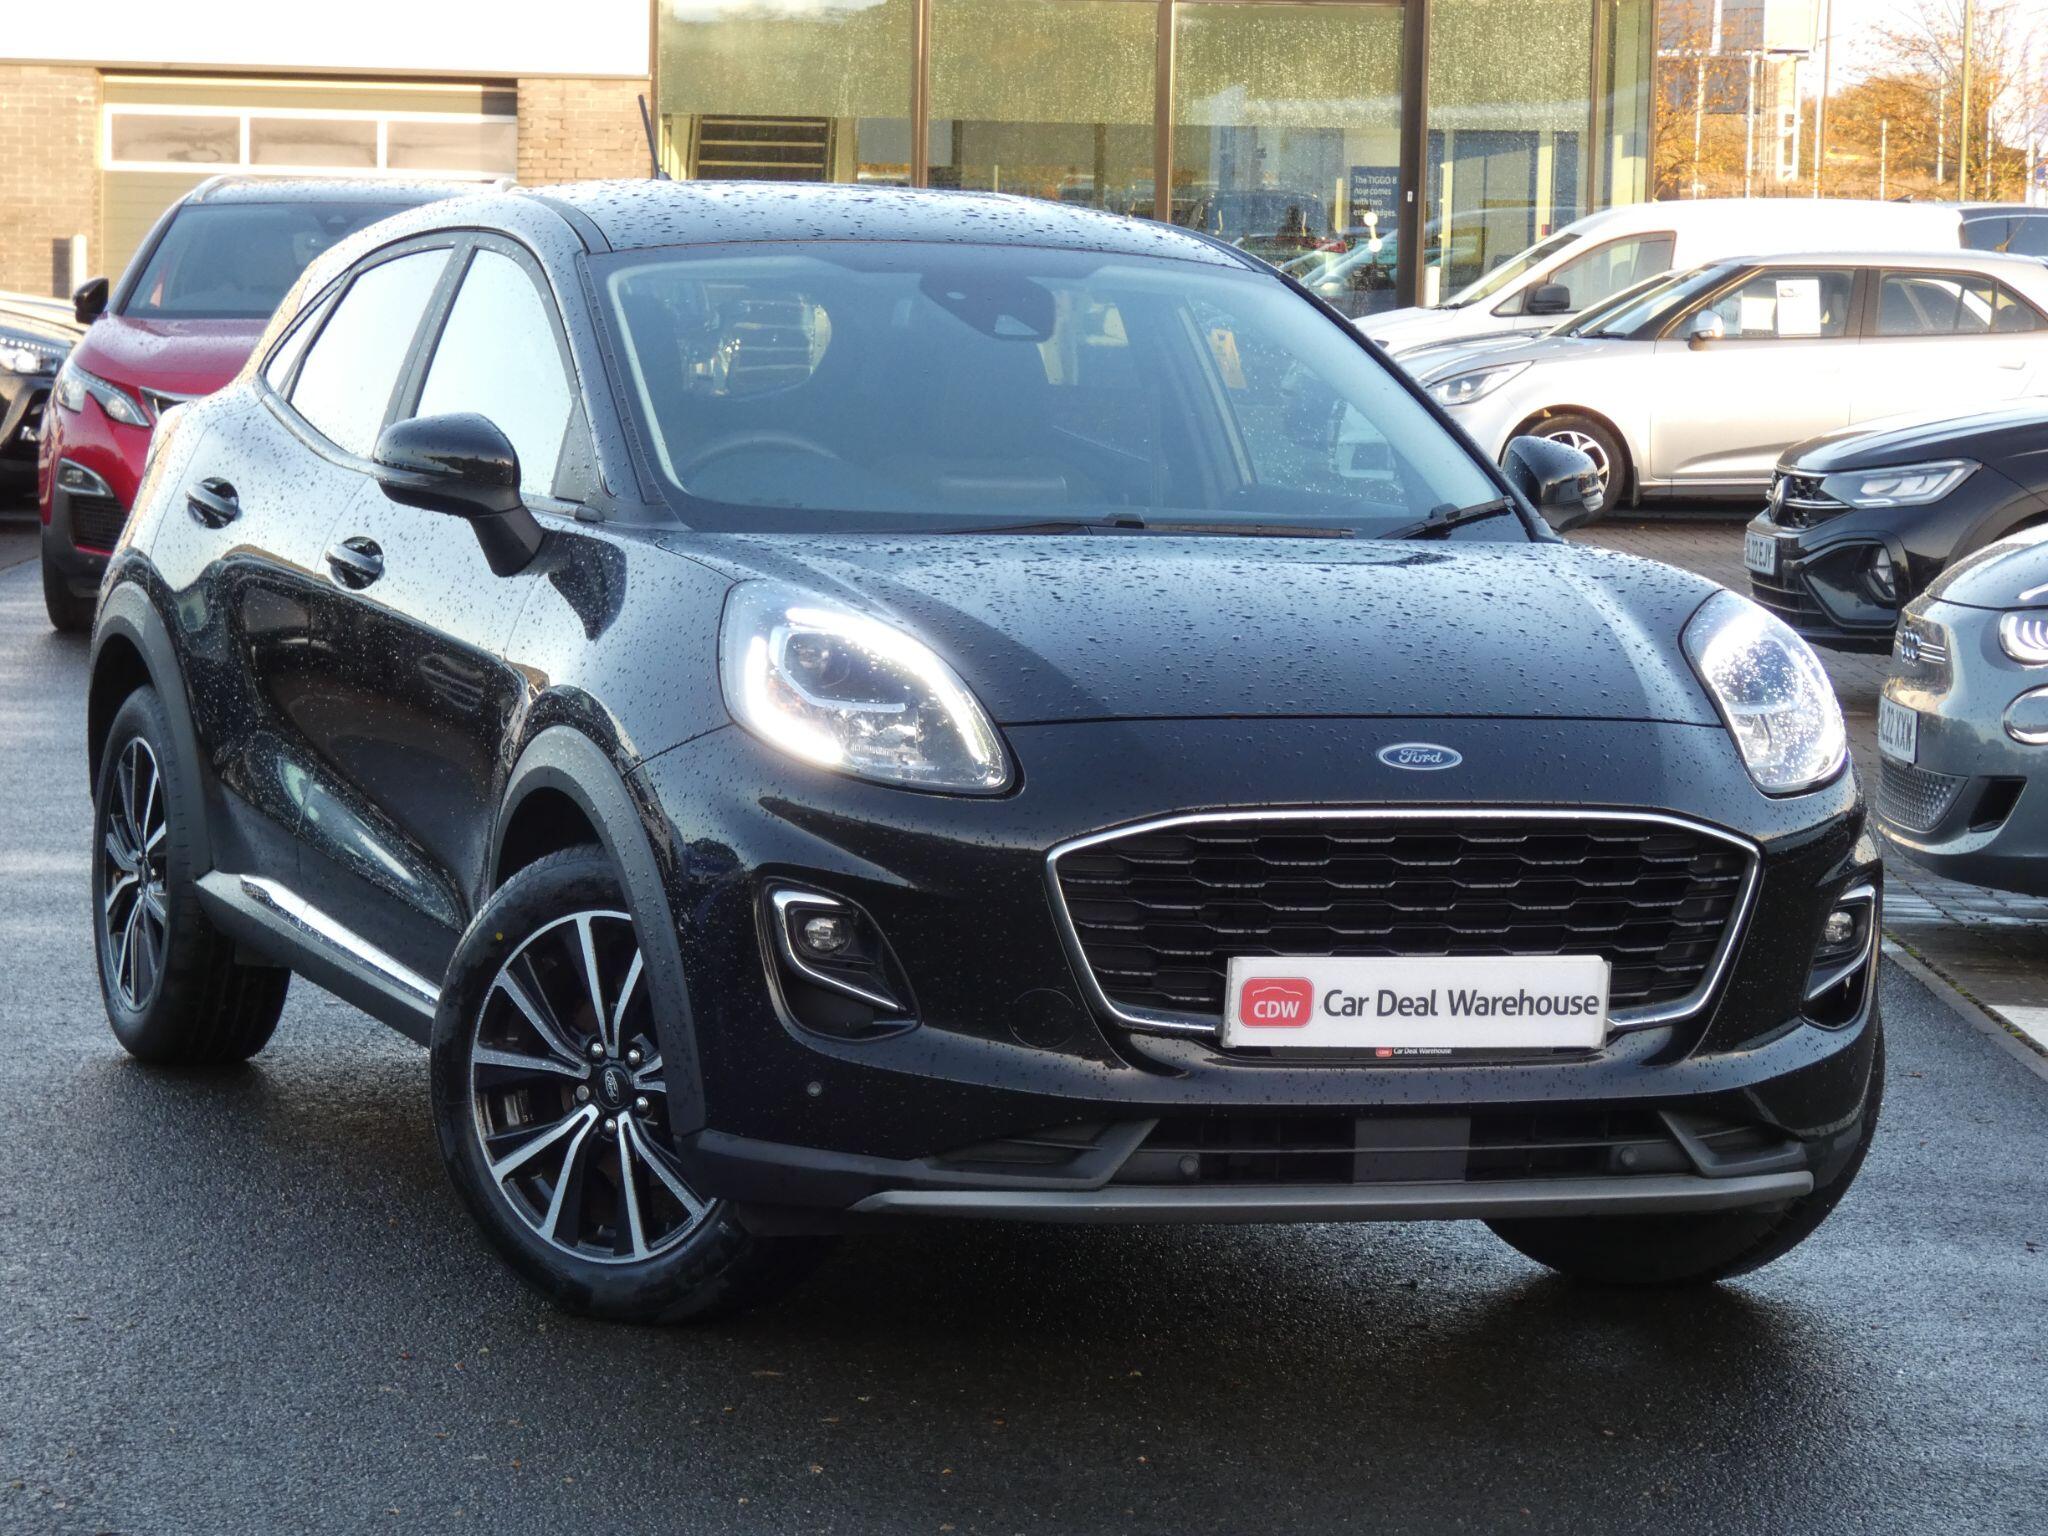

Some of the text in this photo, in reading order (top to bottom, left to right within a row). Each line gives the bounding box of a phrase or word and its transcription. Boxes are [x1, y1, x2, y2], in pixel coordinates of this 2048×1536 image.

[1354, 176, 1367, 184] The
[1369, 176, 1391, 184] TIGGO
[1398, 748, 1443, 763] Ford
[1253, 1000, 1300, 1018] CDW
[1323, 989, 1599, 1017] Car Deal Warehouse
[1393, 1047, 1403, 1055] Car
